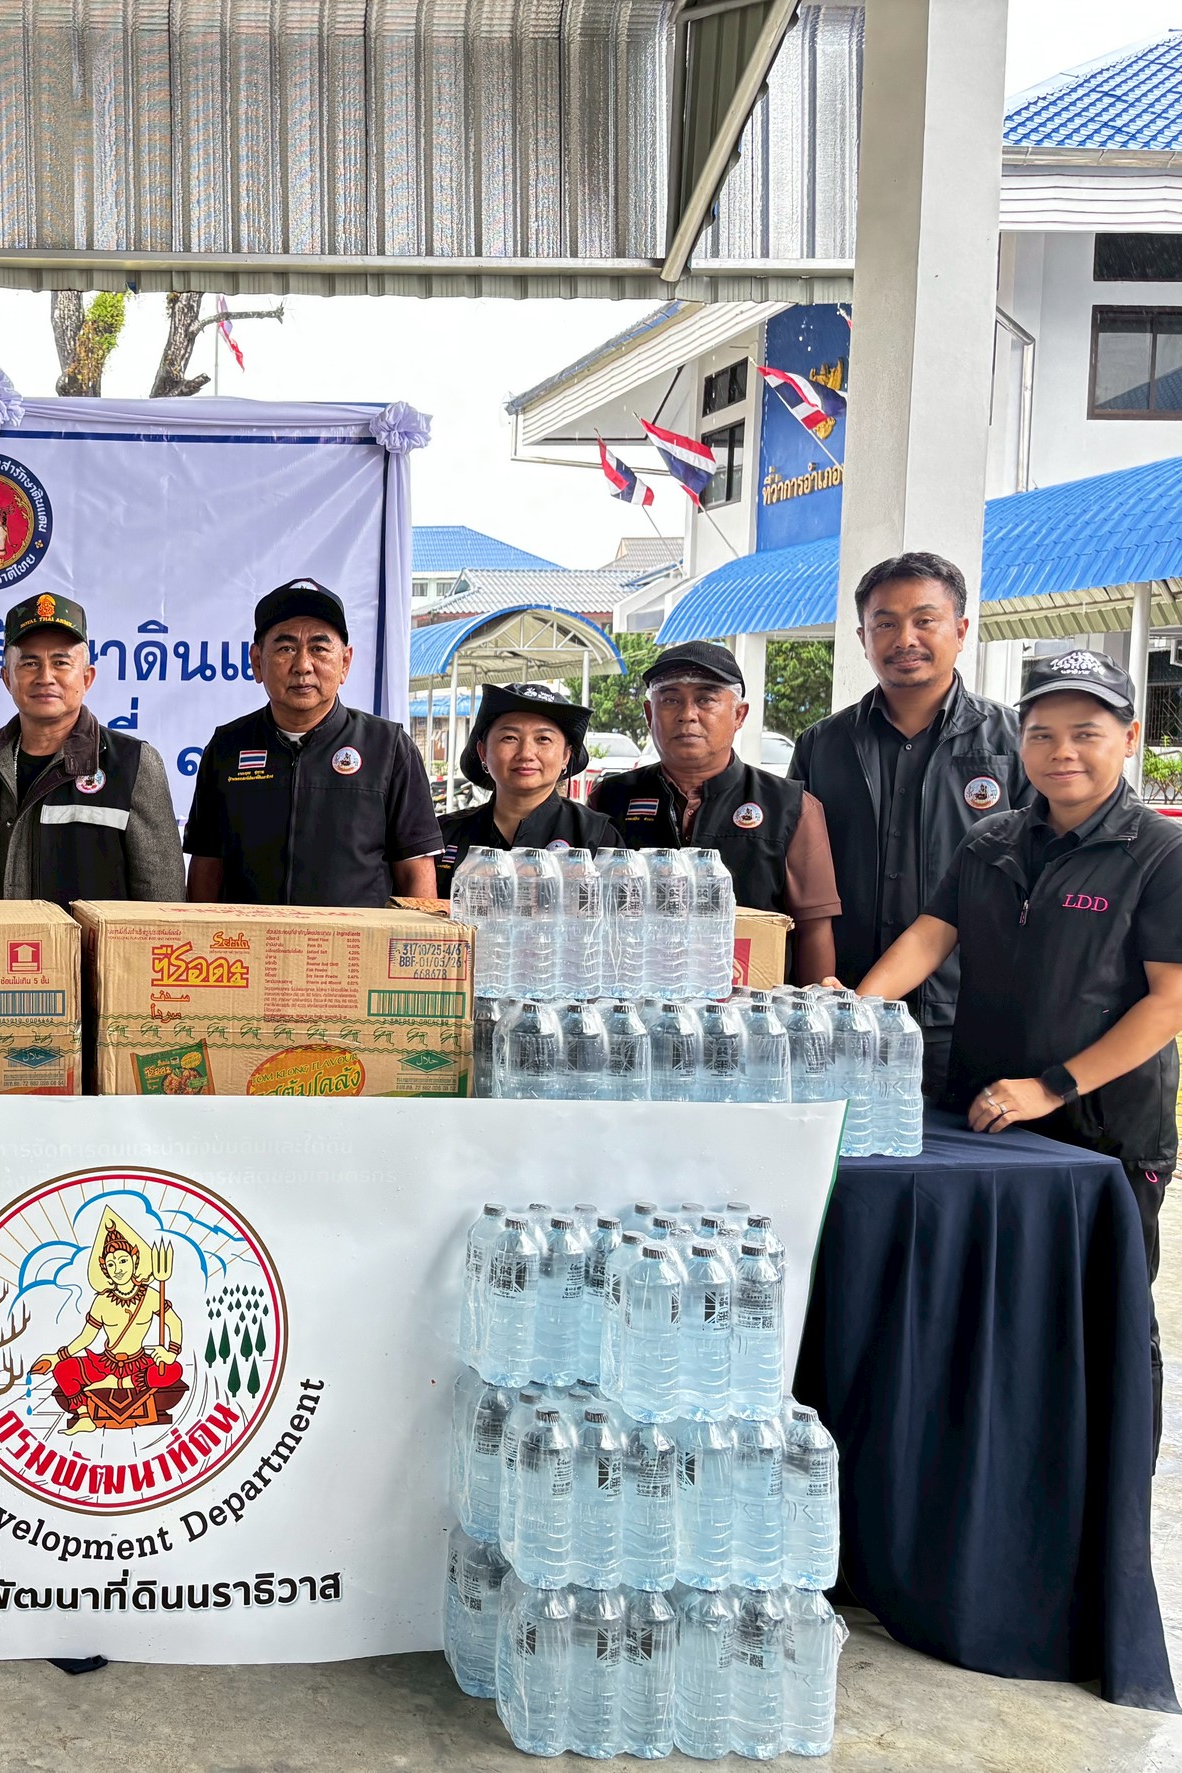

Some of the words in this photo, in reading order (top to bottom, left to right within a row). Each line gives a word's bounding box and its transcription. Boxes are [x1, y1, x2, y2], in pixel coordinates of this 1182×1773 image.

[762, 462, 844, 506] ที่ว่าการอำเภอ
[1062, 894, 1109, 912] LDD
[180, 1378, 326, 1542] Department
